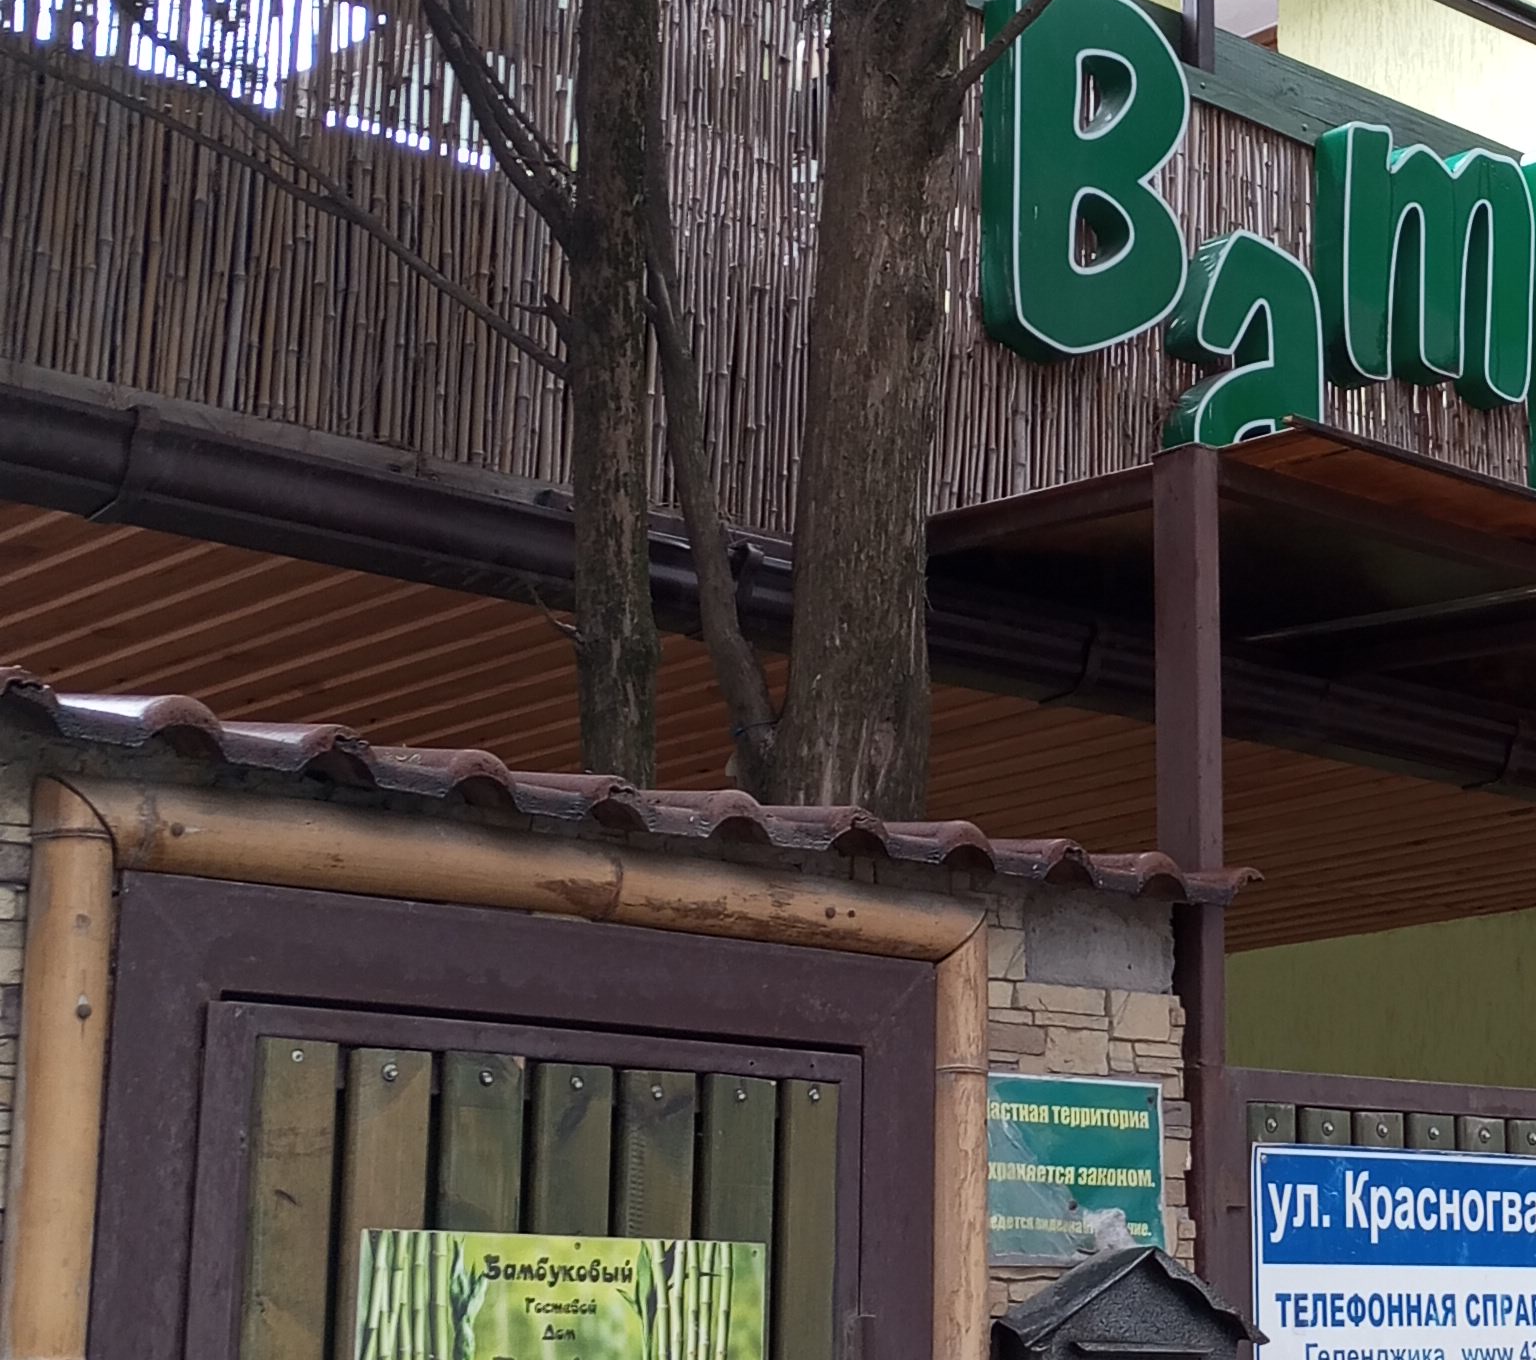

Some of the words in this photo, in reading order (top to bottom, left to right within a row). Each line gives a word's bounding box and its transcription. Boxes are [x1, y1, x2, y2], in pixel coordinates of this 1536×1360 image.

[987, 1099, 1049, 1124] астная
[1051, 1105, 1149, 1129] территория
[988, 1161, 1075, 1185] храняется
[1078, 1167, 1155, 1188] законом.
[1267, 1182, 1331, 1243] ул.
[483, 1253, 634, 1288] Бамбуковый
[524, 1296, 598, 1315] Гостевой
[1275, 1292, 1457, 1328] ТЕЛЕФОННАЯ
[541, 1323, 576, 1341] Дом
